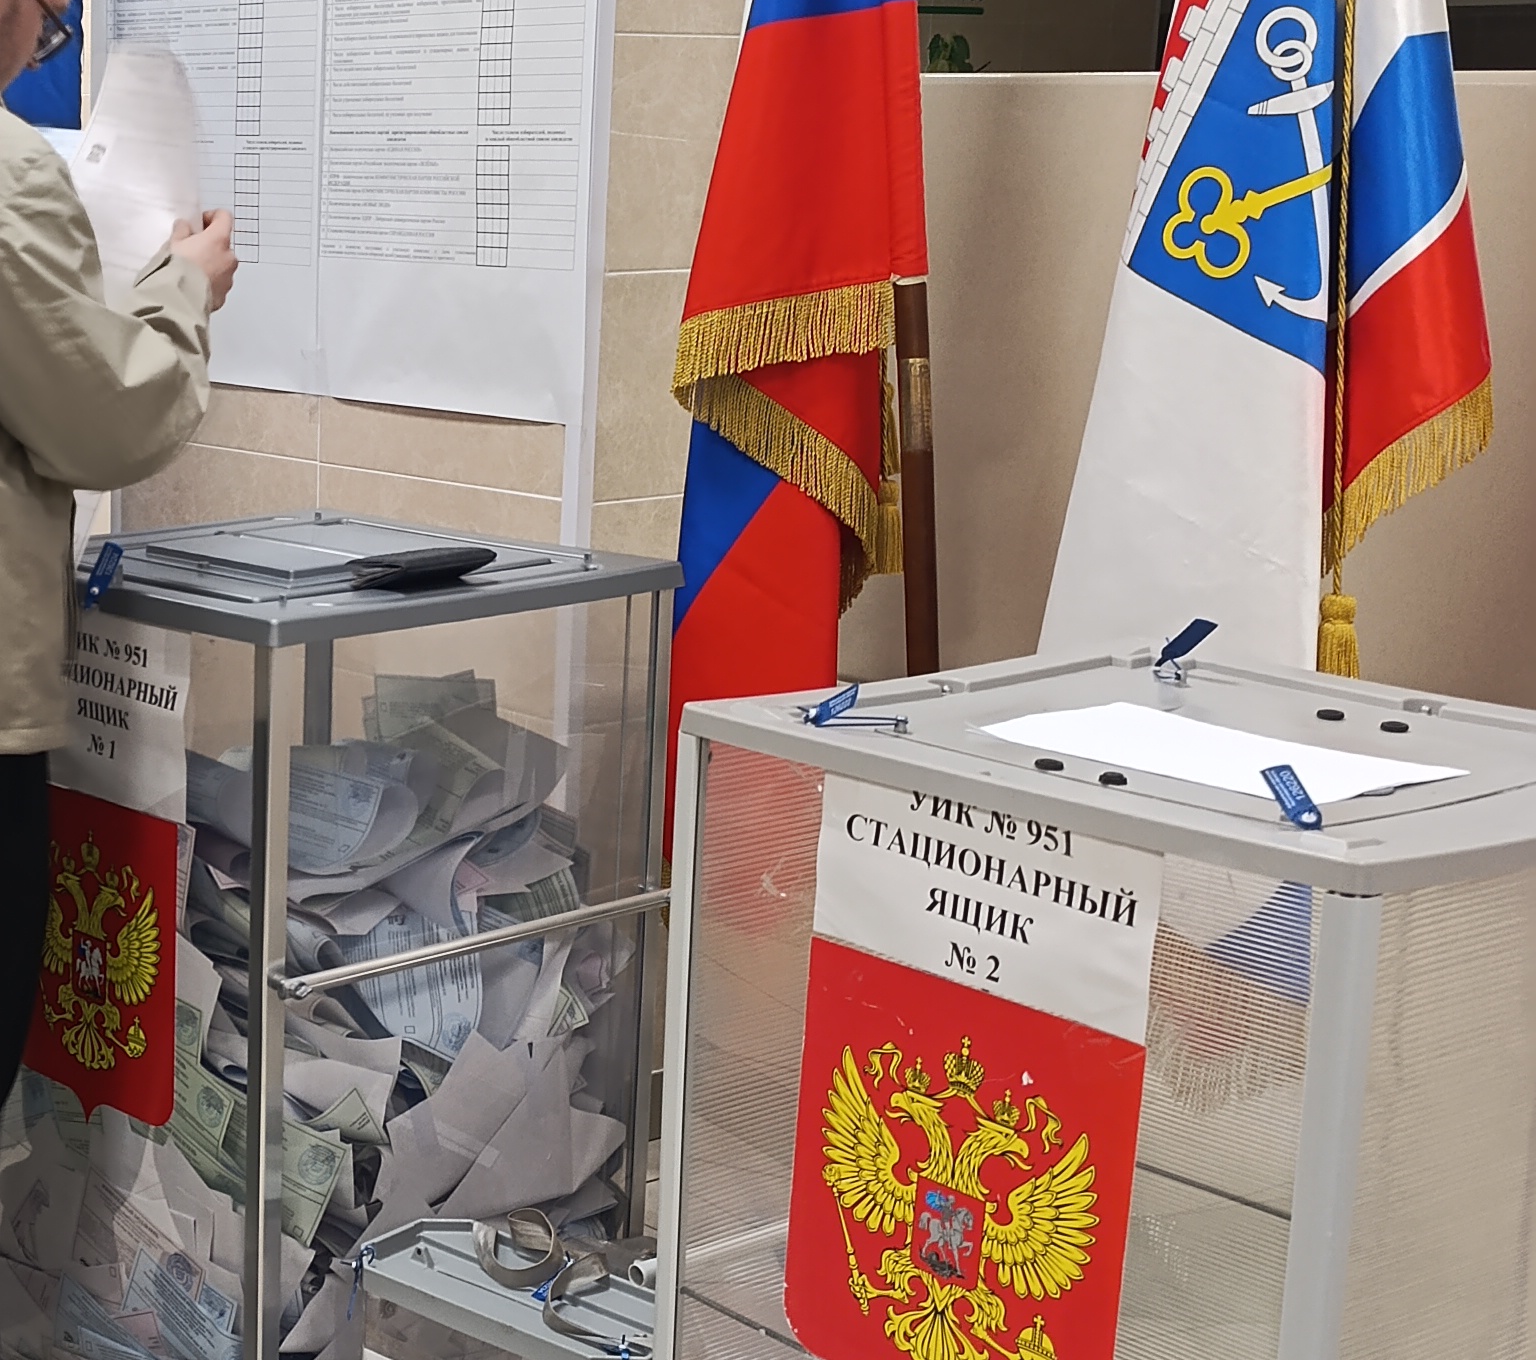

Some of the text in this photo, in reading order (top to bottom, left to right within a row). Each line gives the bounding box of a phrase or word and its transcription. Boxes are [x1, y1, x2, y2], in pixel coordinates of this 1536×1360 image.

[76, 631, 148, 668] ИК № 951
[71, 662, 178, 712] ЦИОНАРНЫЙ
[77, 697, 130, 731] ЯЩИК
[86, 733, 116, 760] № 1
[909, 790, 1075, 859] УИК № 951
[845, 812, 1140, 928] СТАЦИОНАРНЫЙ
[925, 887, 1034, 945] ЯЩИК
[944, 941, 1002, 983] № 2
